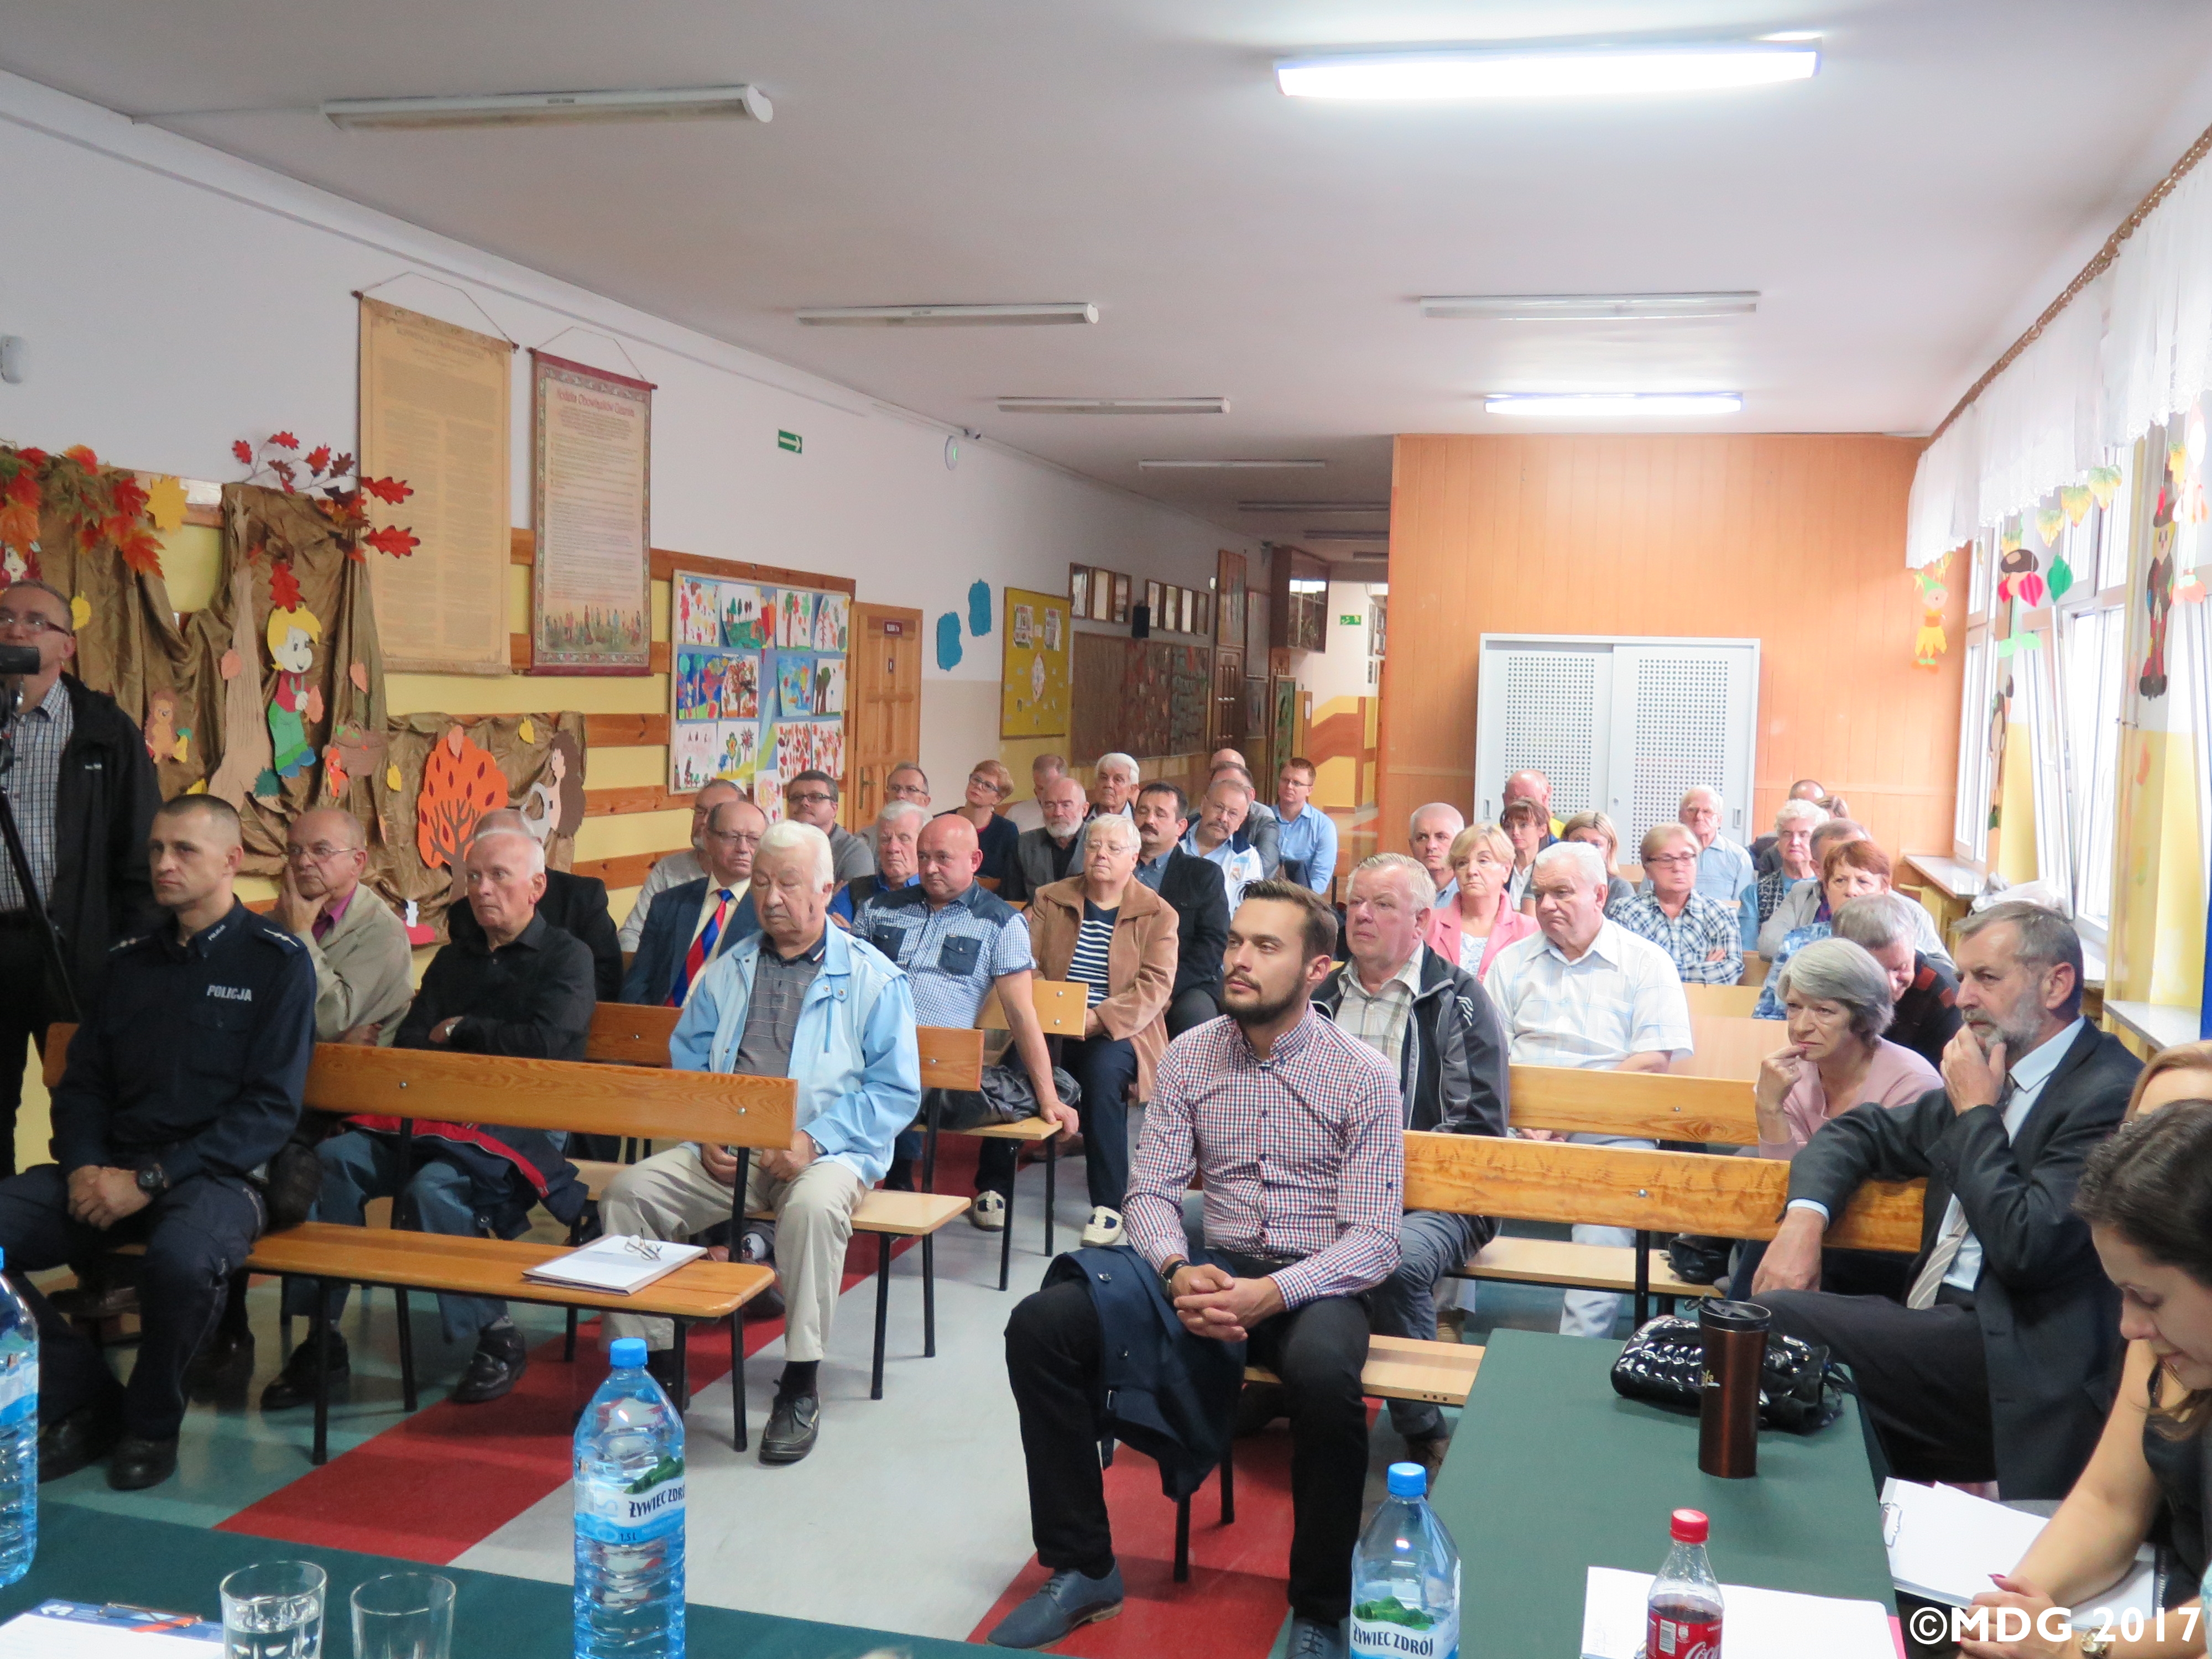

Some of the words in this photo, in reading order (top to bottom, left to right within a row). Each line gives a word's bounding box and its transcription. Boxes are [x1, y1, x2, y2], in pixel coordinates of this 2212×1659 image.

[207, 985, 252, 1001] POLICJA
[629, 1490, 666, 1518] ŻYWIEC
[1353, 1623, 1391, 1647] ŻYWIEC
[1394, 1633, 1434, 1657] ZDRÓJ
